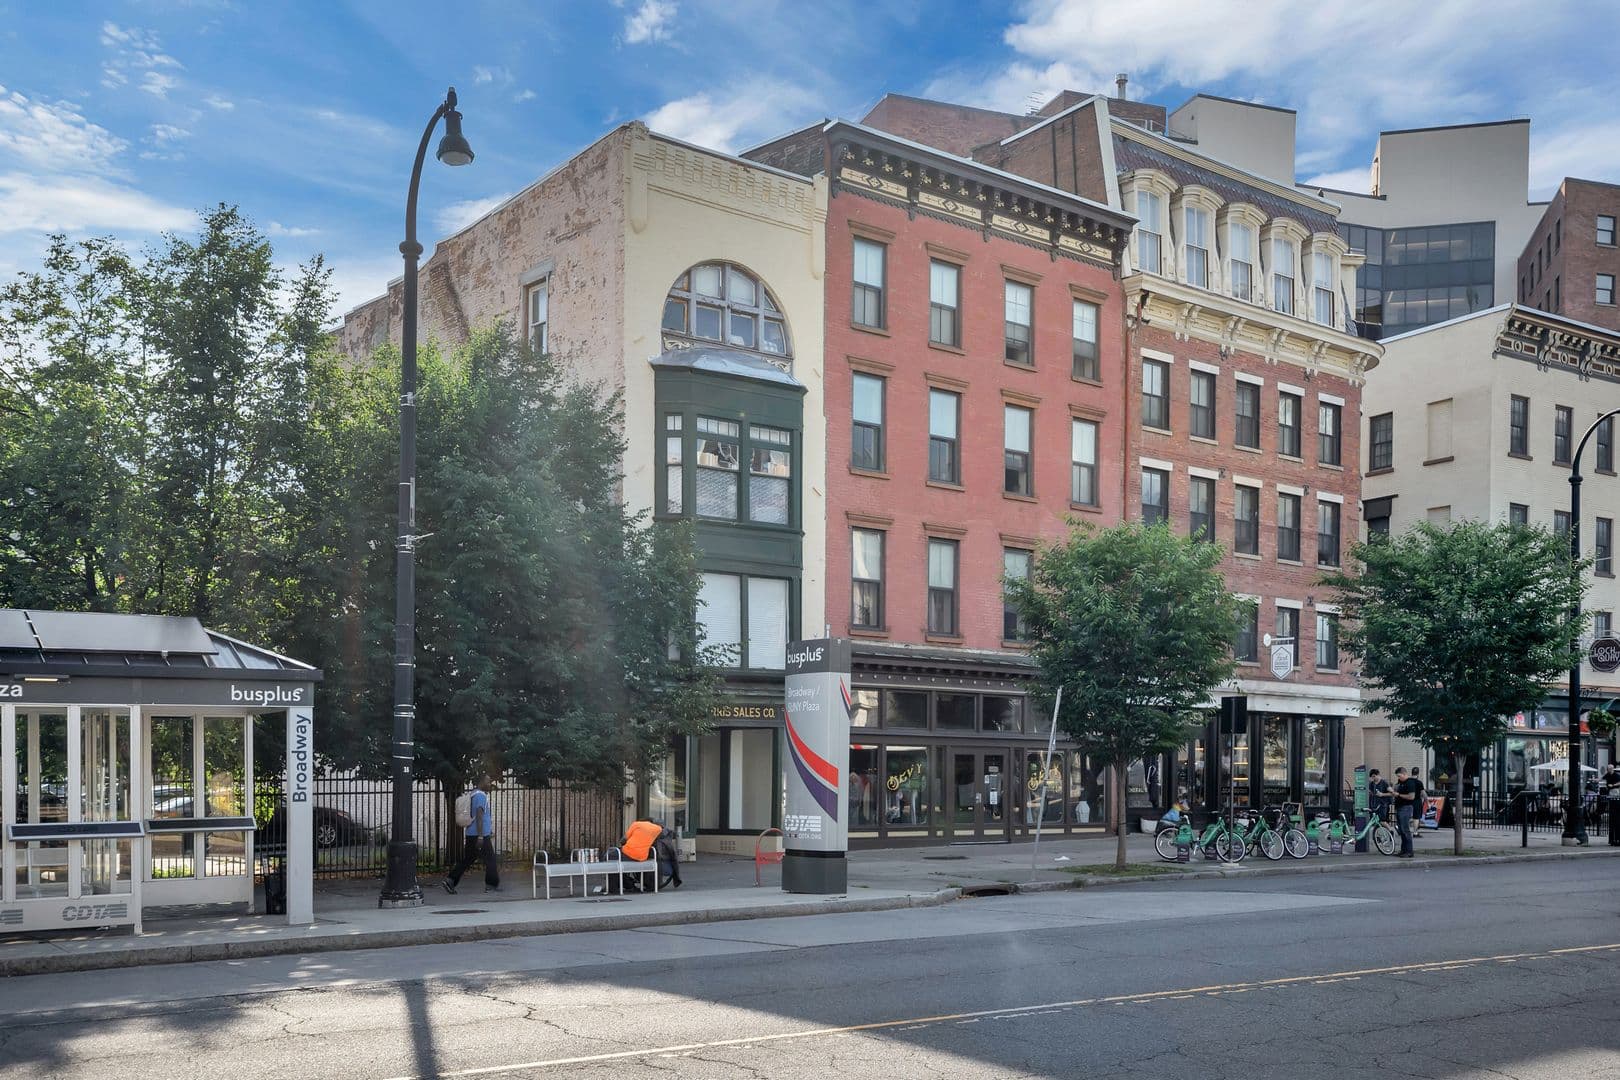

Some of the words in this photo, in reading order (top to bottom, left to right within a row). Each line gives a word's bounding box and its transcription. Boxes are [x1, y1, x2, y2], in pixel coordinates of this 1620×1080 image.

[787, 646, 824, 668] busplus
[231, 684, 304, 706] busplus
[733, 707, 761, 718] SALES
[291, 714, 311, 802] Broadway
[62, 903, 127, 922] CDTA
